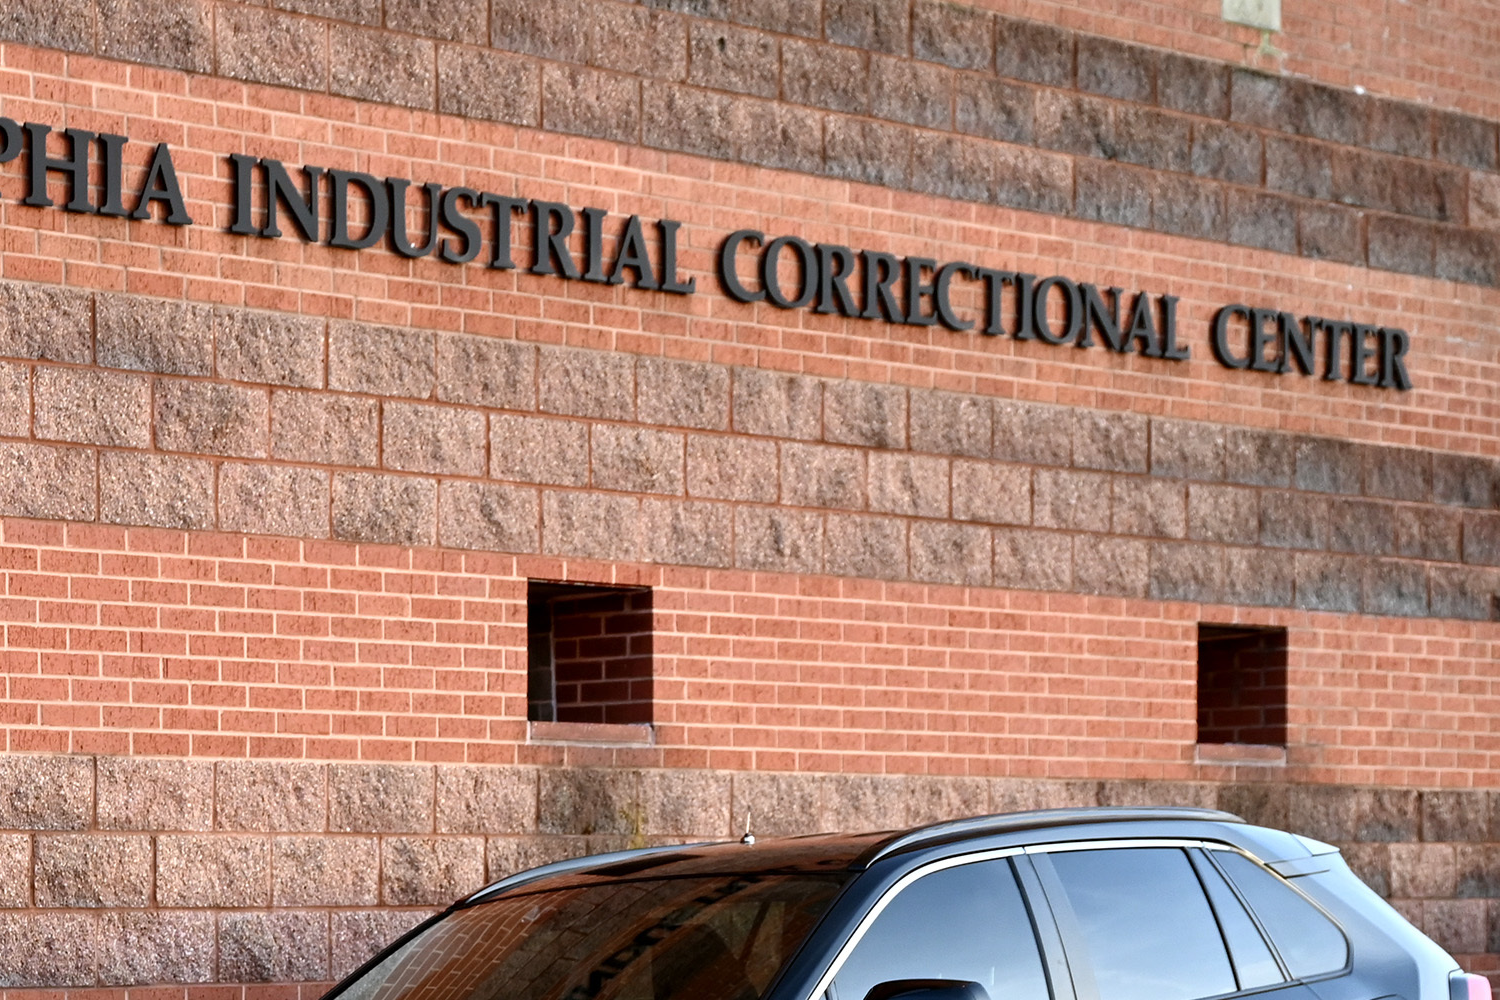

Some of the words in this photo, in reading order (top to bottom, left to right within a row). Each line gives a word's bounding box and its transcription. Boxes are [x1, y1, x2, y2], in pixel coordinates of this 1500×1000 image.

[229, 153, 696, 294] INDUSTRIAL
[719, 229, 1190, 360] CORRECTIONAL
[1211, 304, 1413, 391] CENTER
